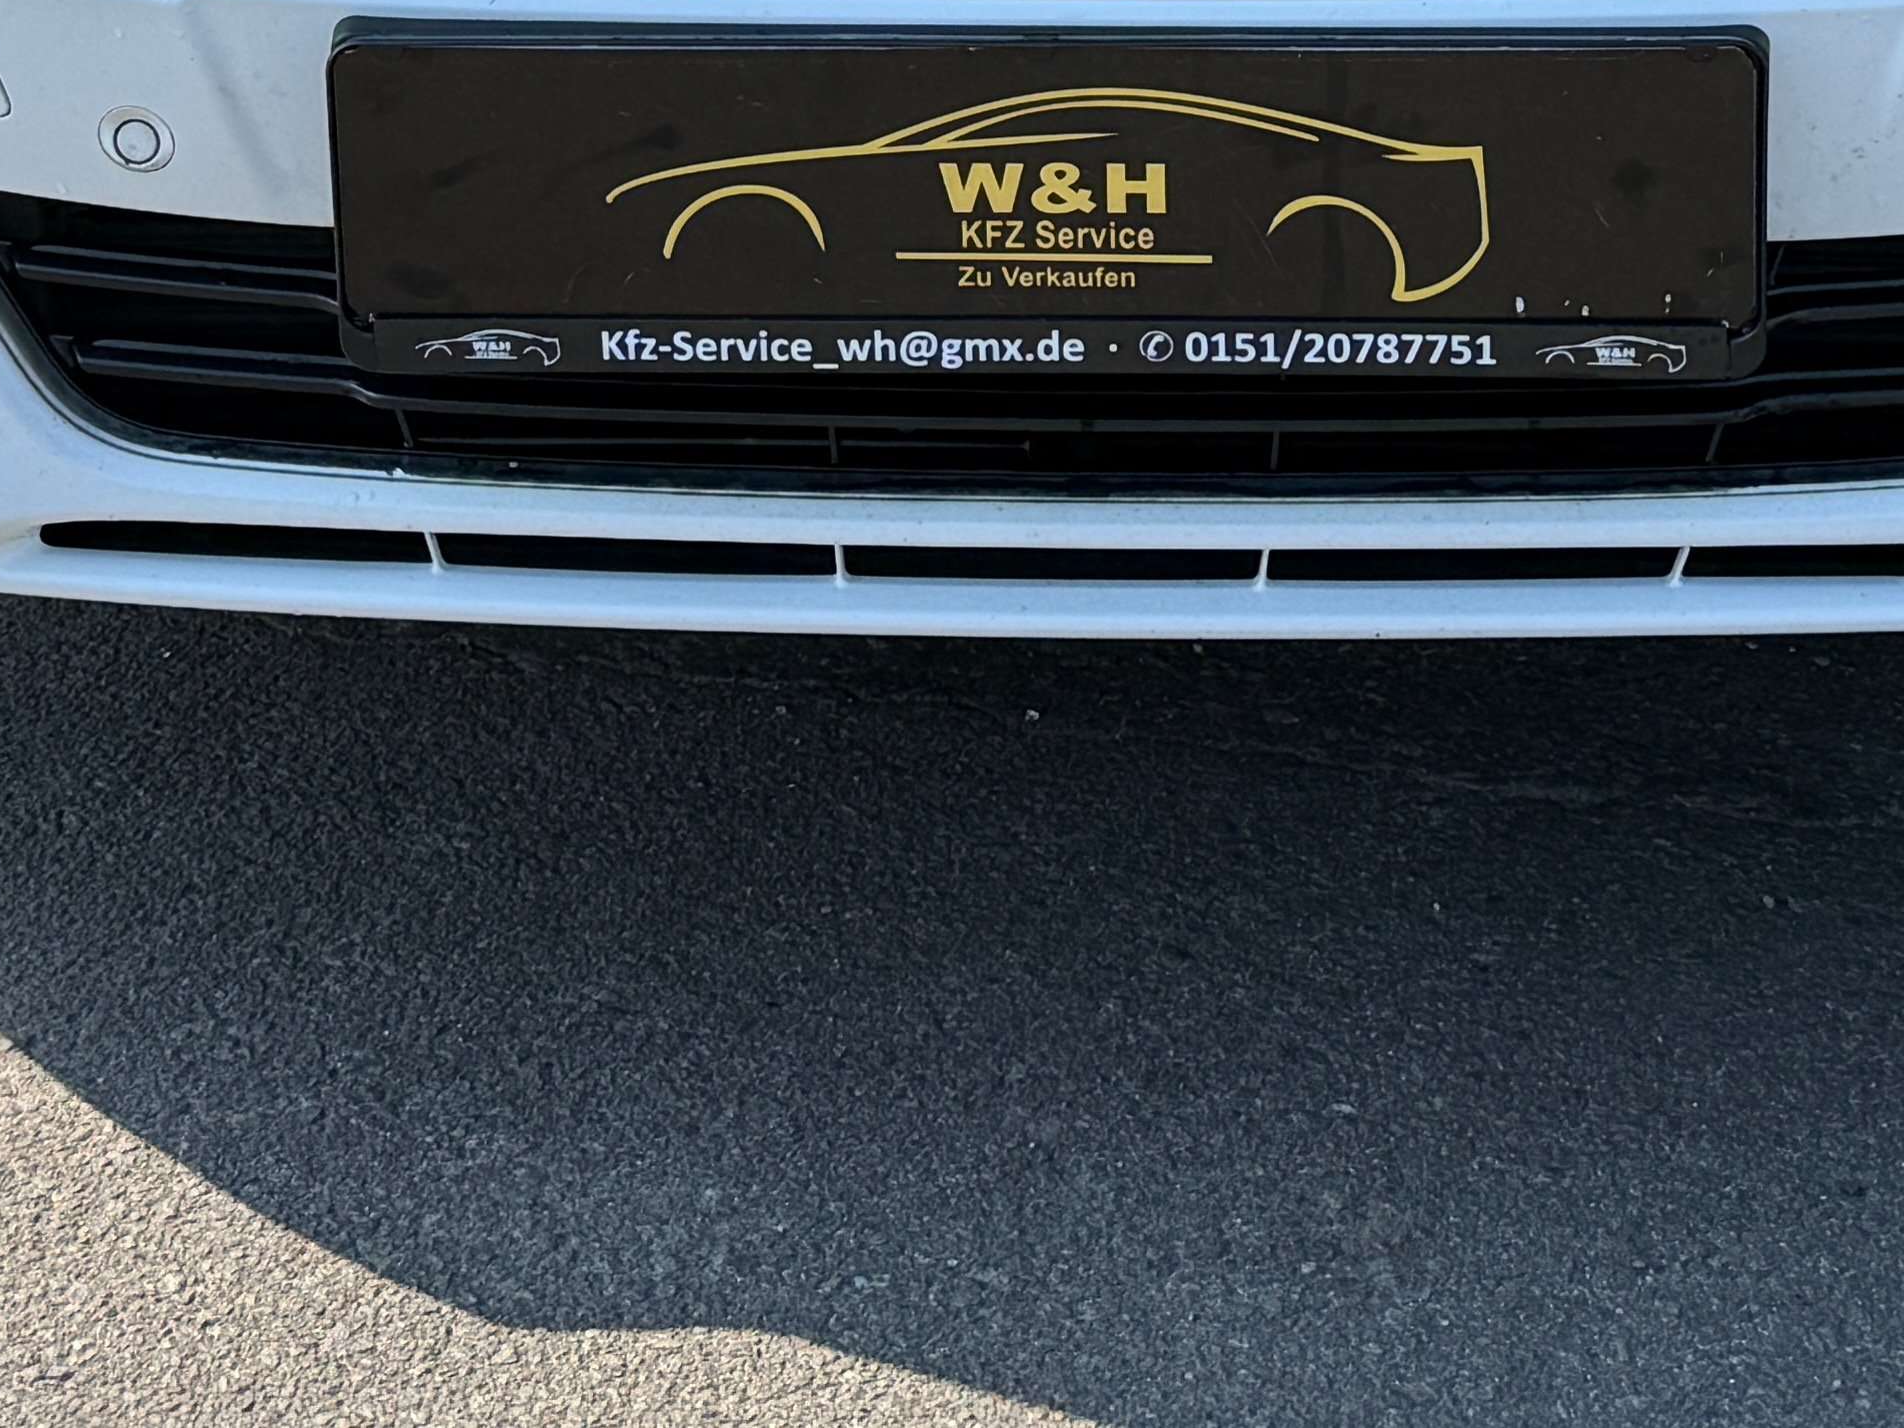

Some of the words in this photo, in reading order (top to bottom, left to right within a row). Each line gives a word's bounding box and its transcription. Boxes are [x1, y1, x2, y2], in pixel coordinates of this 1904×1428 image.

[939, 163, 1166, 213] W&H
[962, 221, 1025, 248] KFZ
[1036, 220, 1153, 249] Service
[959, 267, 991, 286] Zu
[1002, 267, 1135, 287] Verkaufen
[602, 329, 1084, 369] Kfz-Service_wh@gmx.de
[1186, 329, 1496, 369] 0151/20787751
